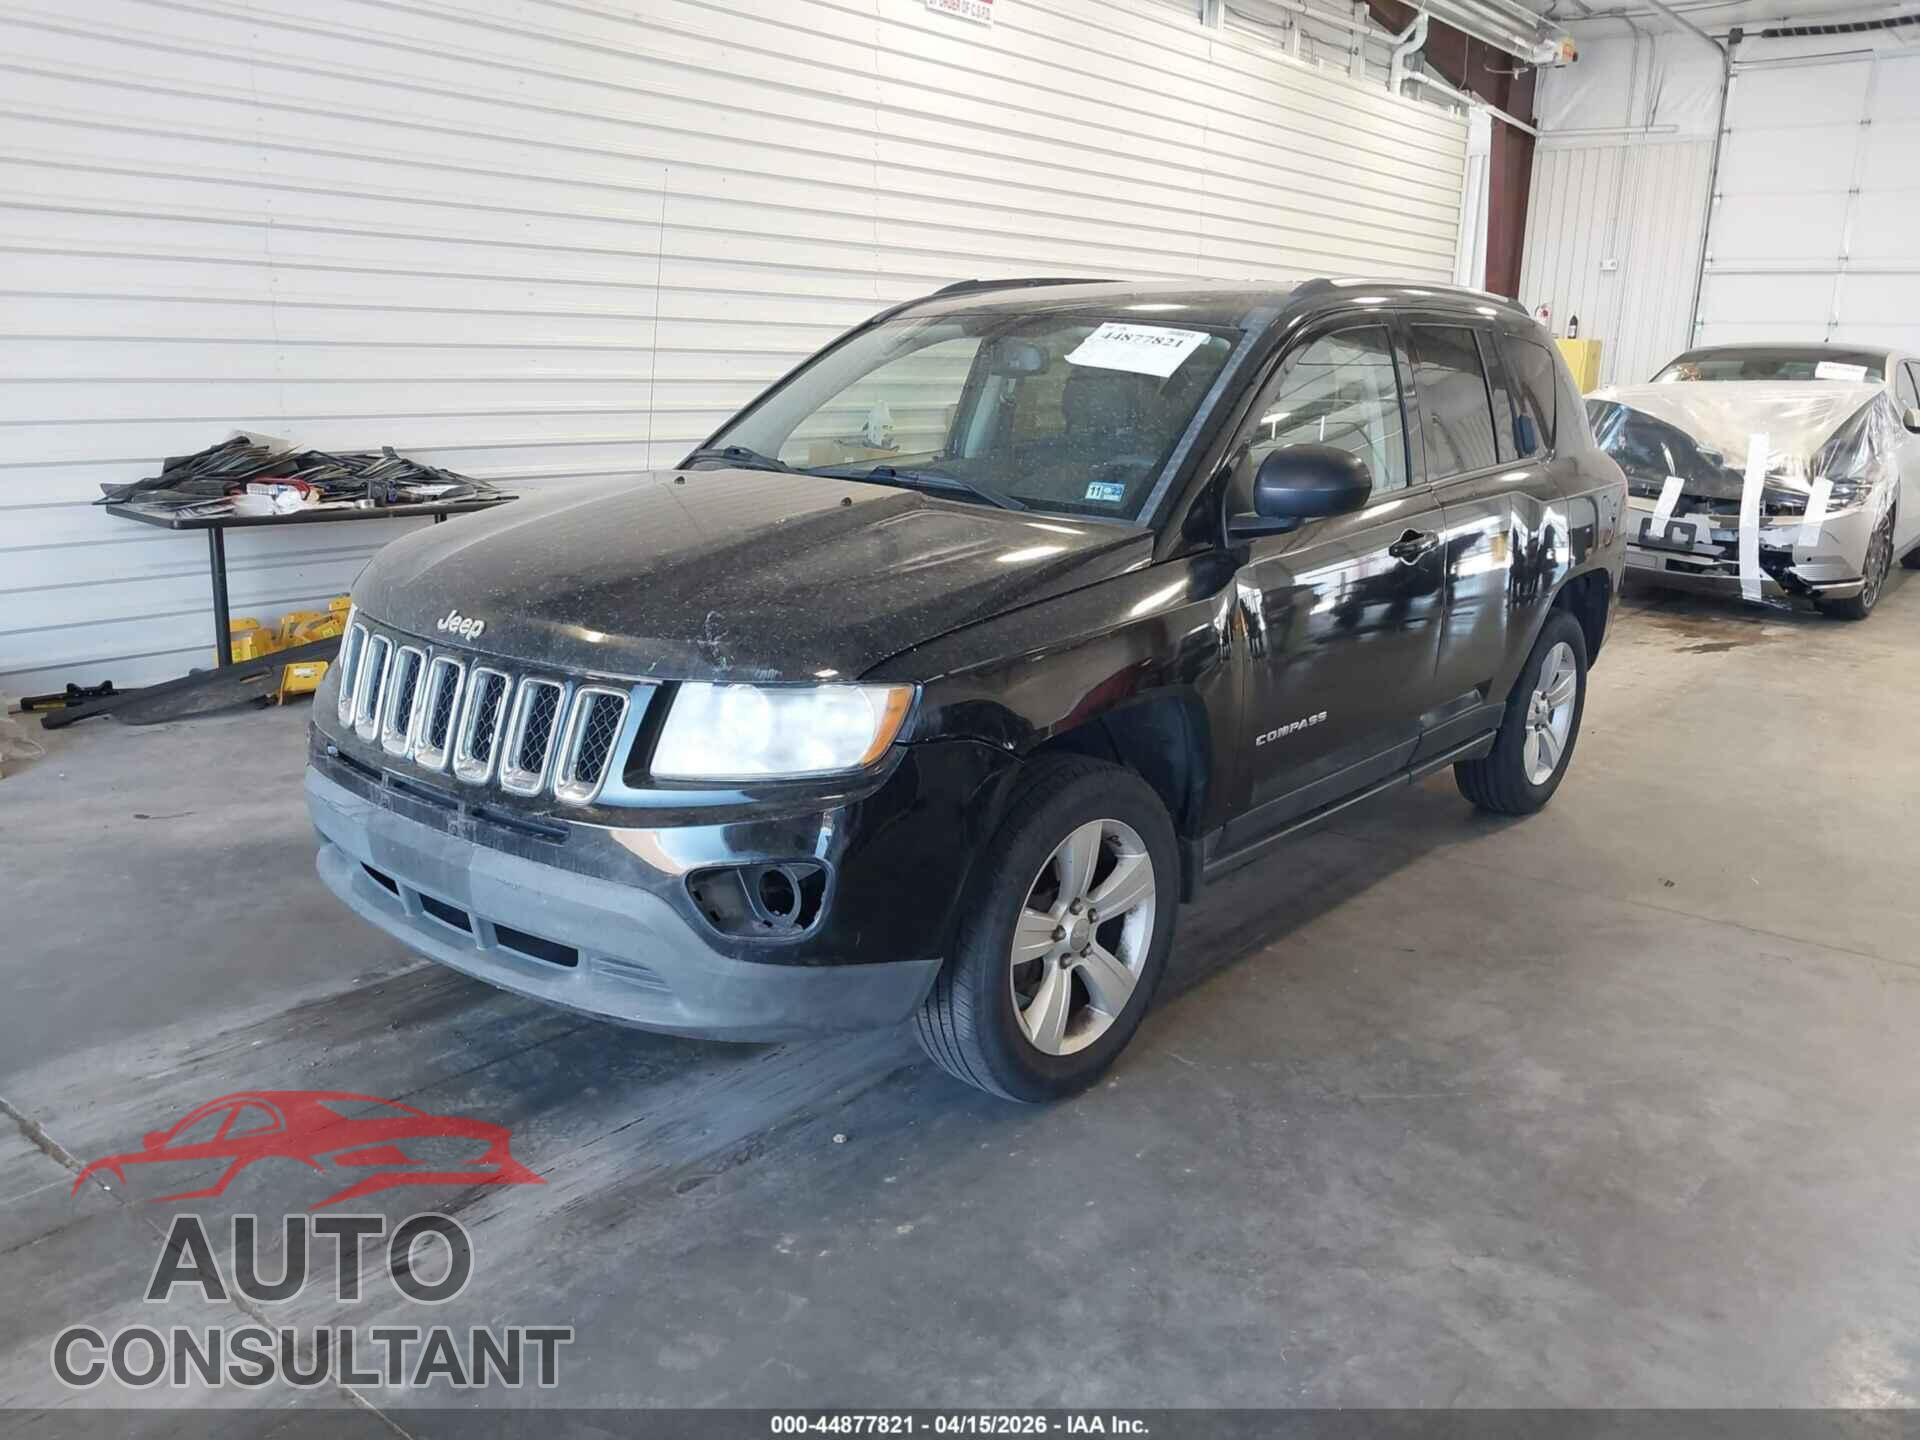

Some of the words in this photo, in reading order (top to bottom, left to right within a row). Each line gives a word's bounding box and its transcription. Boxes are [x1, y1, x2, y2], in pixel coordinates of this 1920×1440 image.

[1101, 332, 1184, 347] 44877821
[437, 609, 485, 642] Jeep
[1255, 711, 1328, 746] COMPASS
